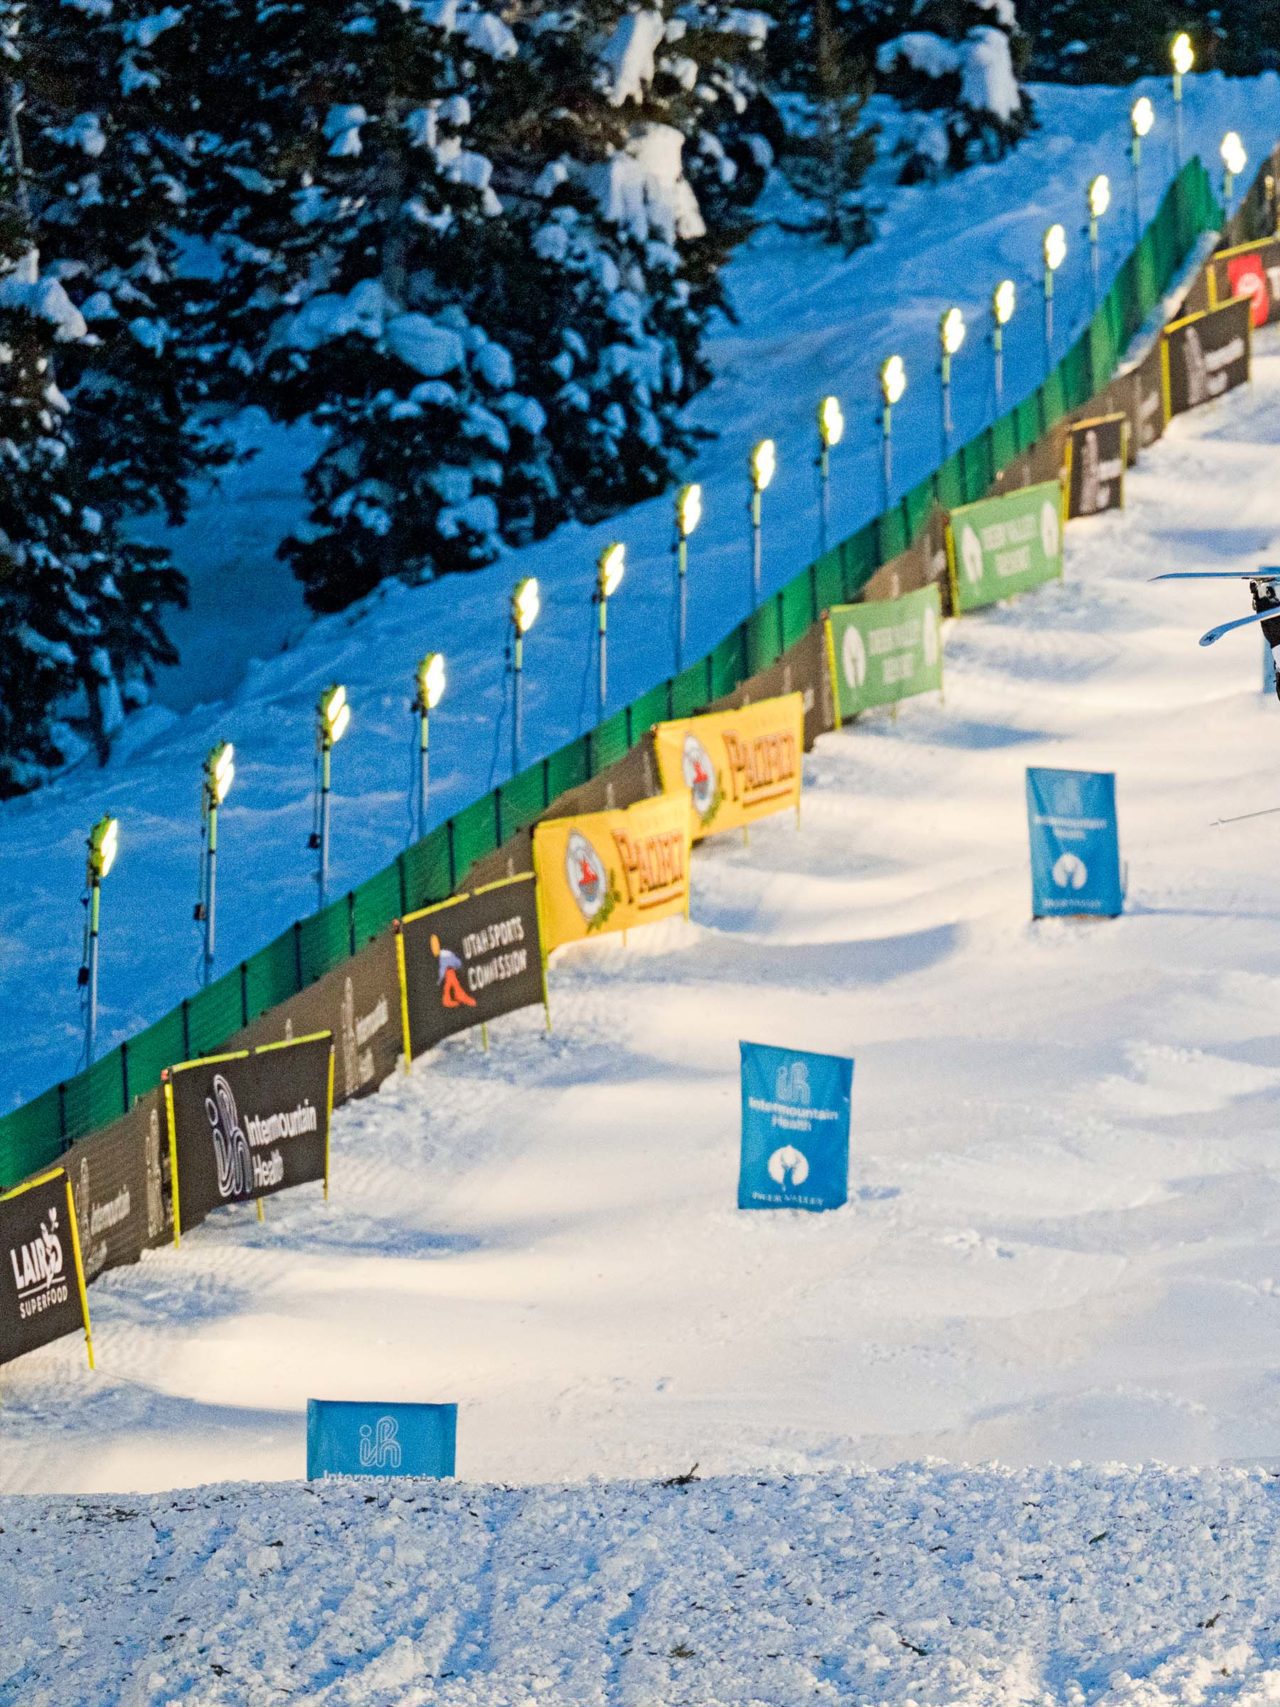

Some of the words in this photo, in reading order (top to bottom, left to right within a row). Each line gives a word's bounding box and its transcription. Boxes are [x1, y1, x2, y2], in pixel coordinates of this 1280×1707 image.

[244, 1098, 318, 1147] Intermountain
[252, 1148, 285, 1188] Health
[10, 1232, 63, 1290] LAIRD
[19, 1284, 69, 1319] SUPERFOOD
